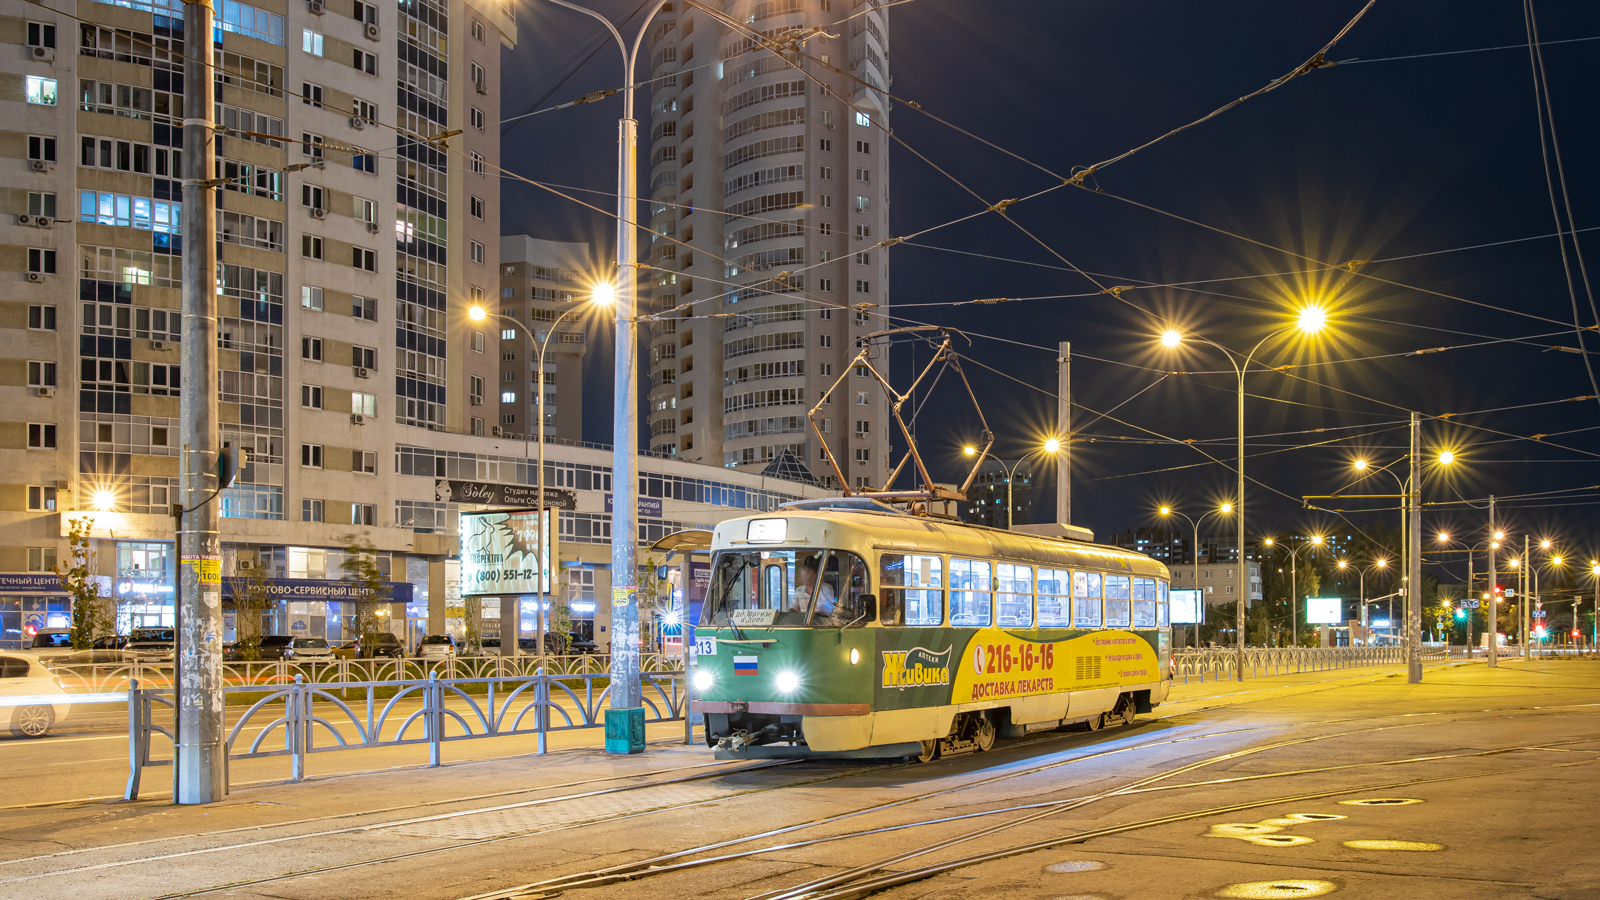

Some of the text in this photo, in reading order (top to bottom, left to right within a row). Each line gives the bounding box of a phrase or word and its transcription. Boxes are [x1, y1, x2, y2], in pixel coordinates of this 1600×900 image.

[504, 486, 528, 495] Студия
[504, 496, 525, 504] Ольги
[476, 569, 500, 583] (800)
[249, 585, 347, 596] ТОРГОВО-СЕРВИСНЫЙ
[348, 587, 375, 597] ЦЕНТР
[918, 651, 939, 663] АПТЕКИ
[986, 642, 1054, 675] 216-16-16
[883, 652, 949, 686] Живика
[972, 681, 1016, 701] ДОСТАВКА
[1017, 677, 1054, 694] ЛЕКАРСТВ
